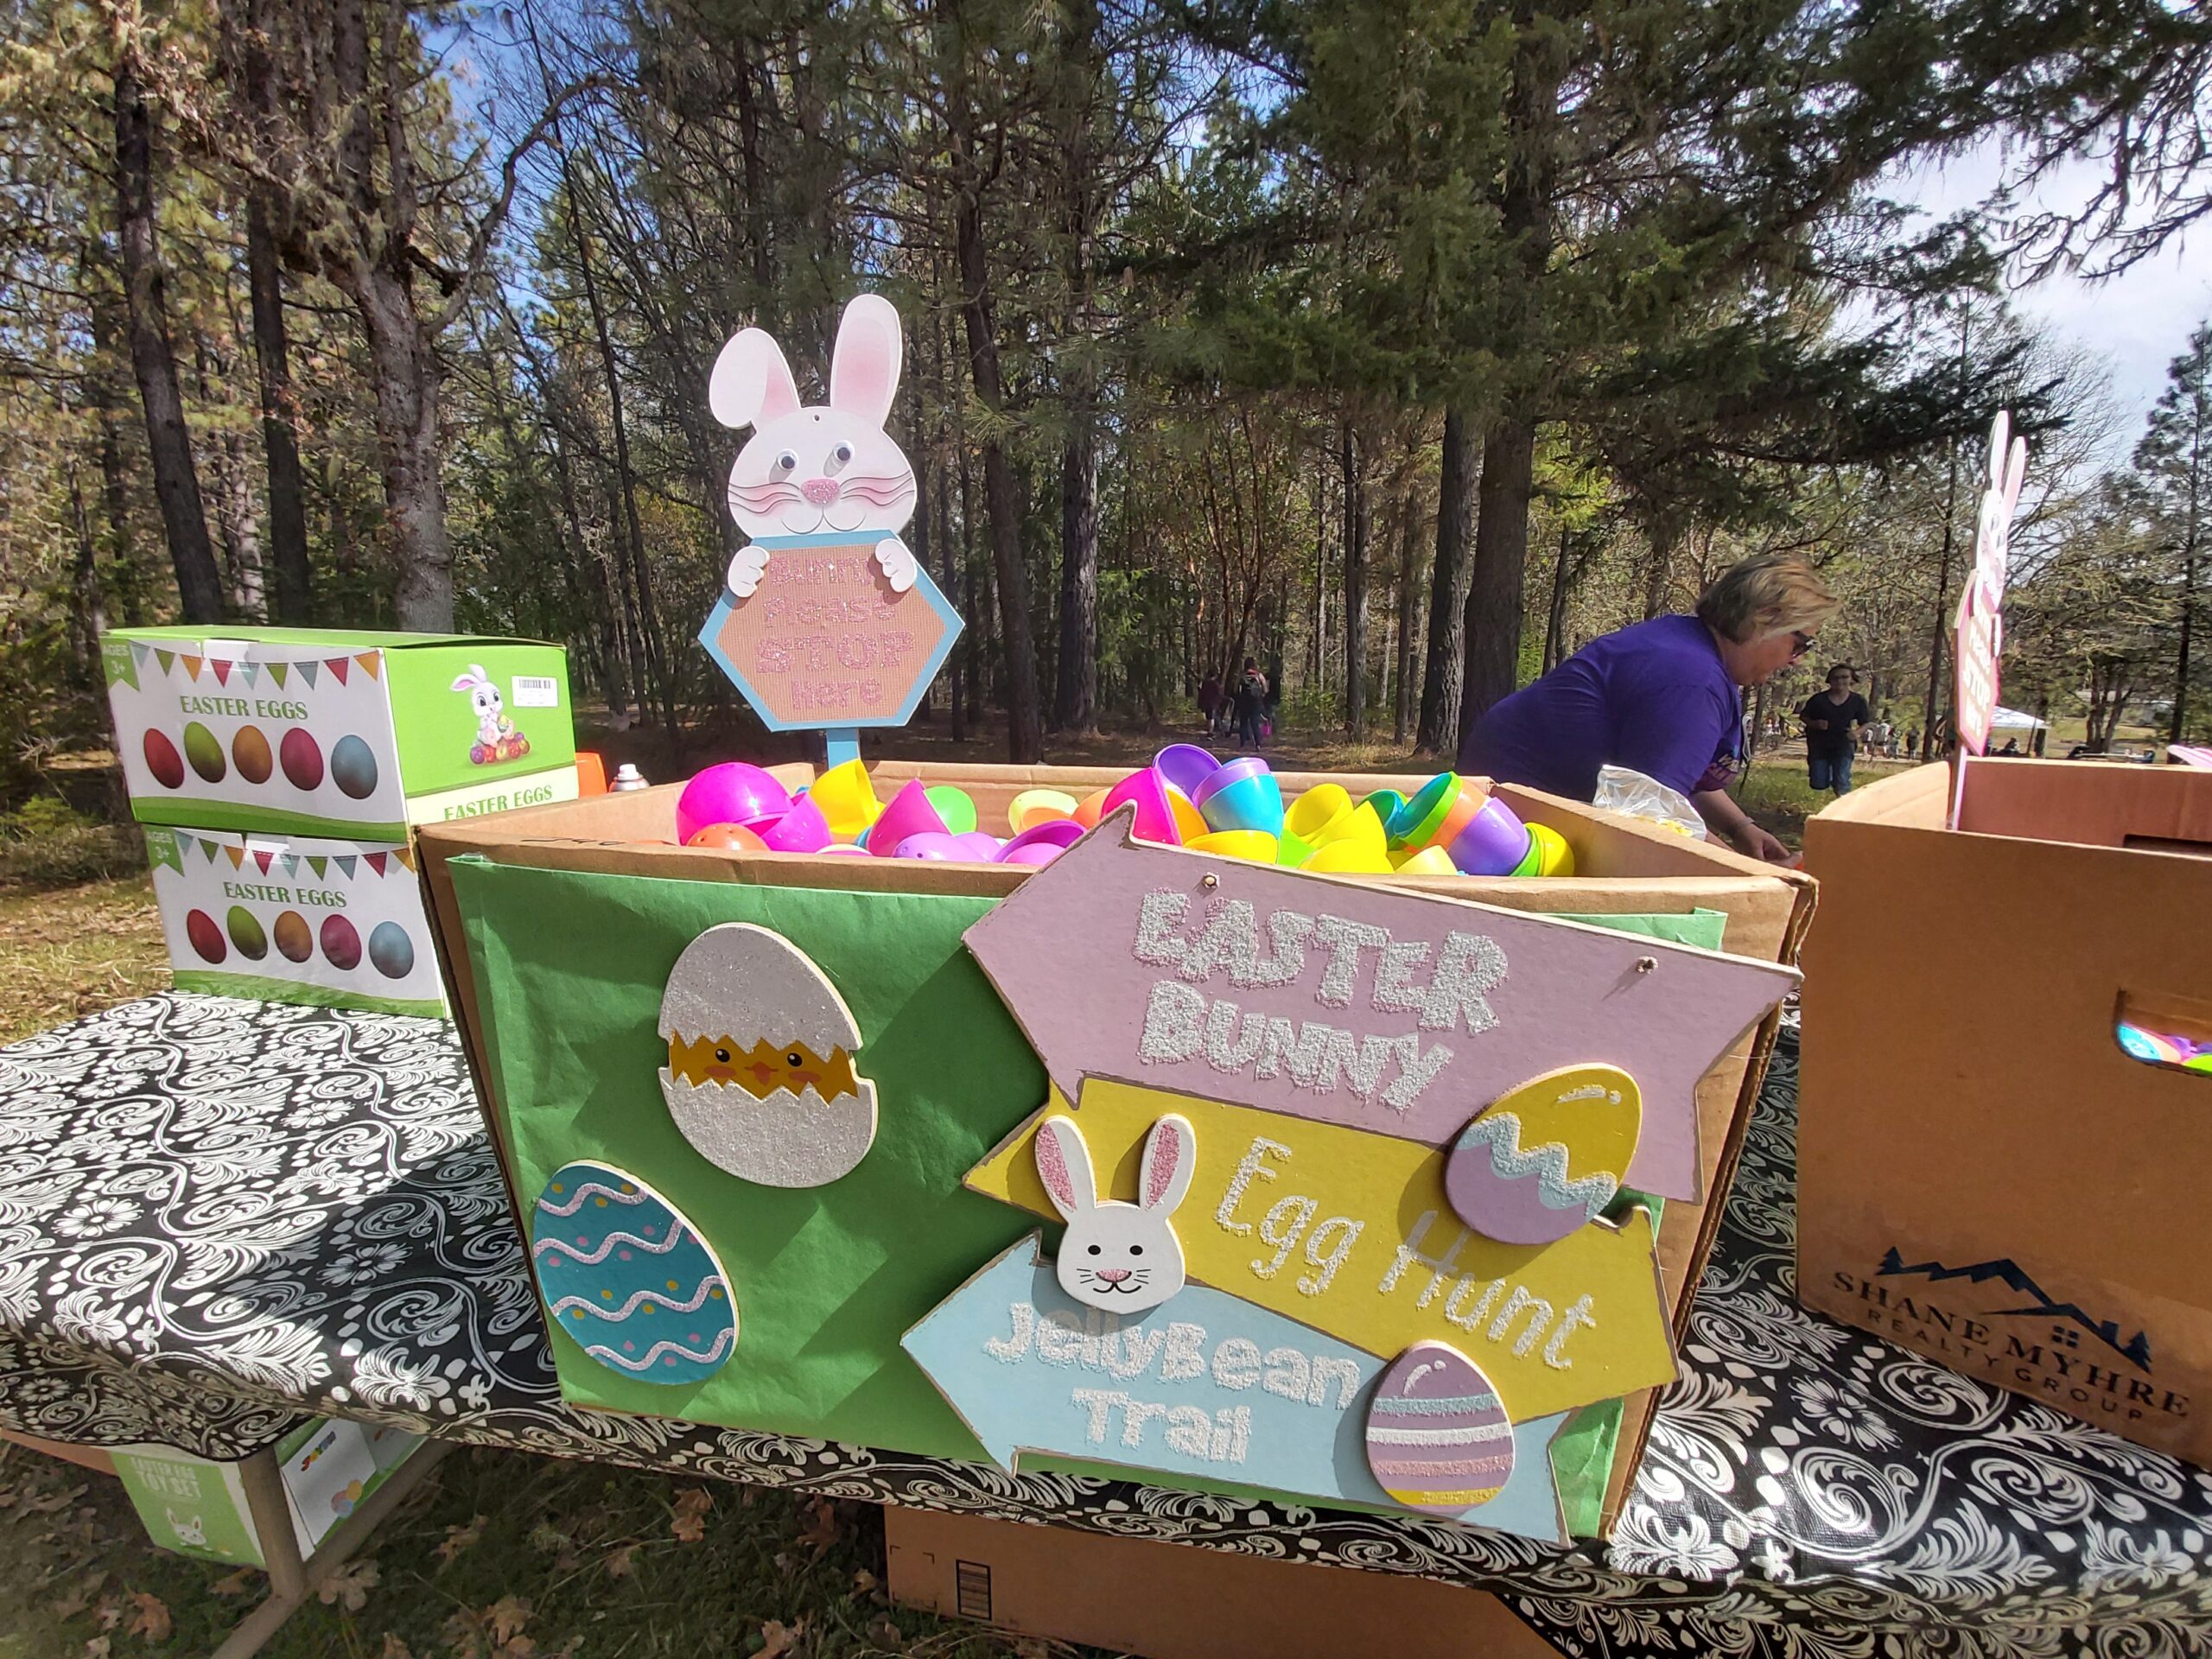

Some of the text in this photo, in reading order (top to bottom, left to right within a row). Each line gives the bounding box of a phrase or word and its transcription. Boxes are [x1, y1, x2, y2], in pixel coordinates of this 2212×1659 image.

[764, 594, 896, 628] Please
[755, 631, 915, 674] STOP
[1962, 652, 1992, 712] STOP
[179, 695, 309, 721] EASTER EGGS
[443, 785, 553, 822] EASTER EGGS
[222, 880, 347, 908] EASTER EGGS
[1132, 886, 1510, 1036] EASTER
[1136, 980, 1455, 1115] BUNNY
[1213, 1135, 1597, 1370] Egg Hunt
[1833, 1270, 2191, 1418] SHANE MYHRE
[1867, 1307, 2145, 1421] REALTY GROUP
[1071, 1387, 1252, 1466] Trail
[136, 1471, 202, 1499] TOY SET
